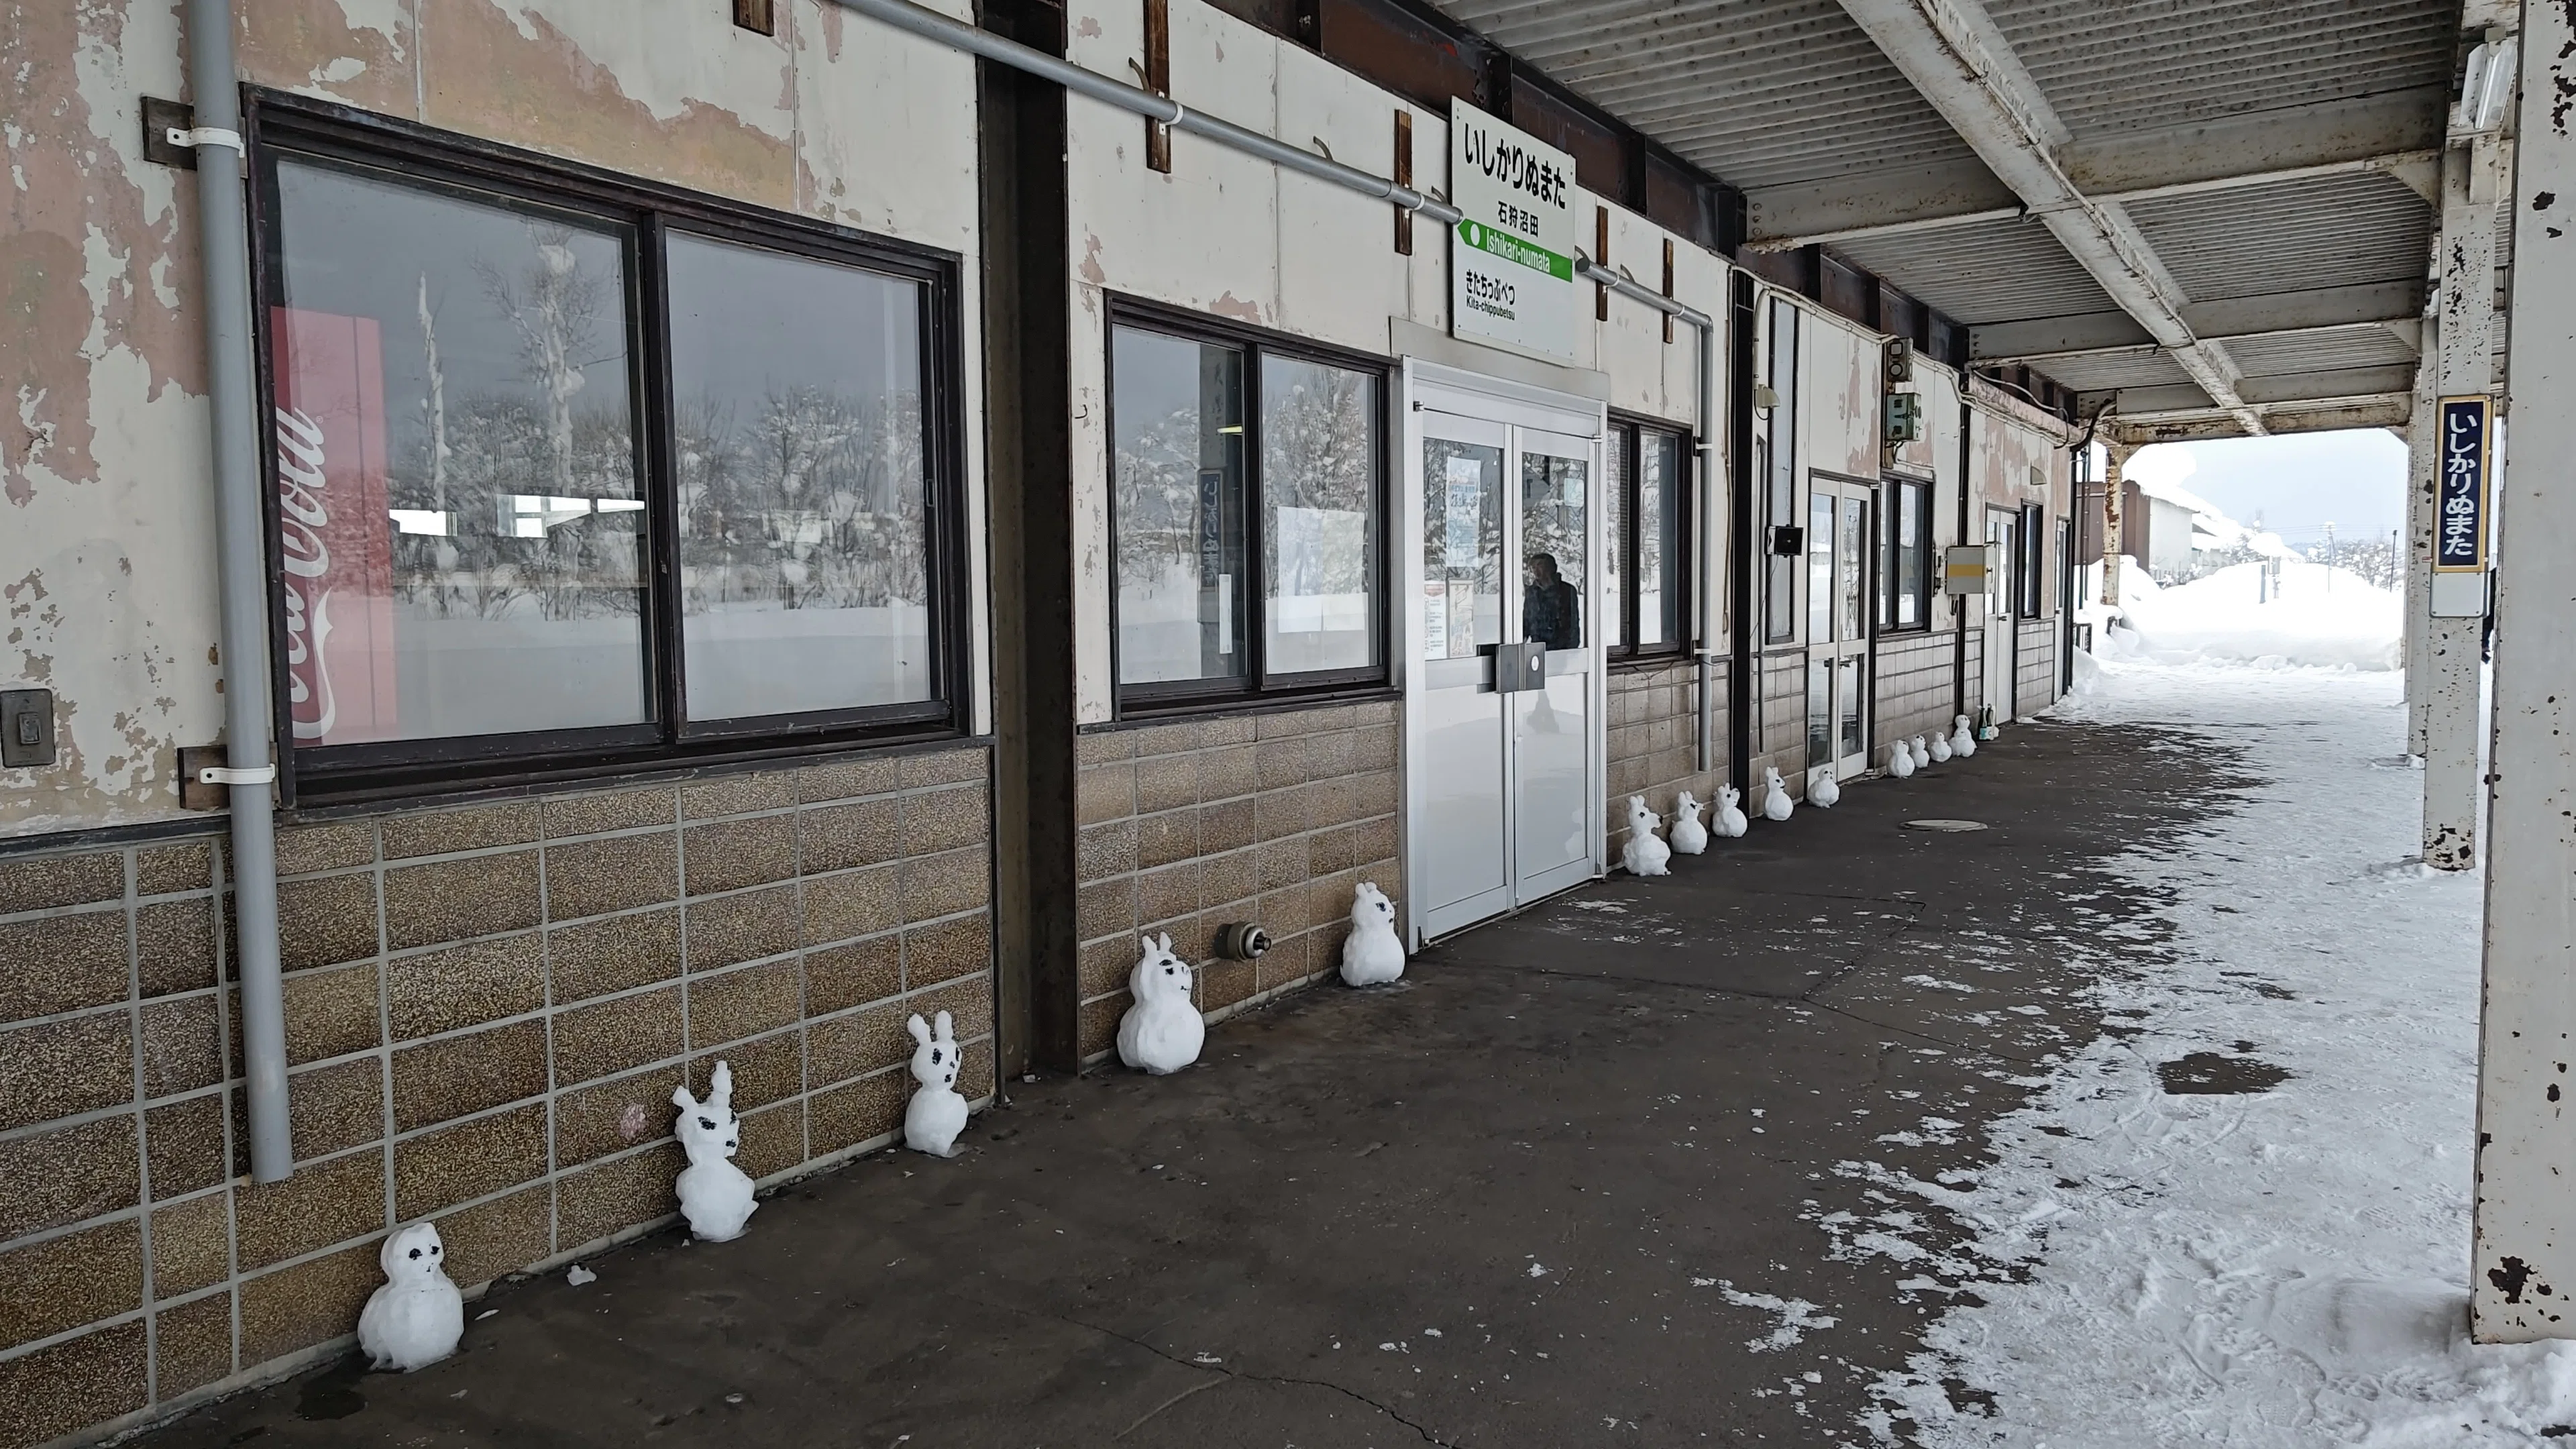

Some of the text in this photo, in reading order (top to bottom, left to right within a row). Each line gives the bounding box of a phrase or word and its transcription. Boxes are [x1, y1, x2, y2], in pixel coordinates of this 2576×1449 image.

[1464, 122, 1566, 210] いしかりぬまた
[1485, 228, 1551, 274] Ishikari-numata
[1497, 200, 1539, 238] 石狩沼田
[1466, 294, 1515, 321] Kita-chippubetsu
[2444, 412, 2478, 557] いしかりぬまた
[275, 406, 335, 740] CocaCola
